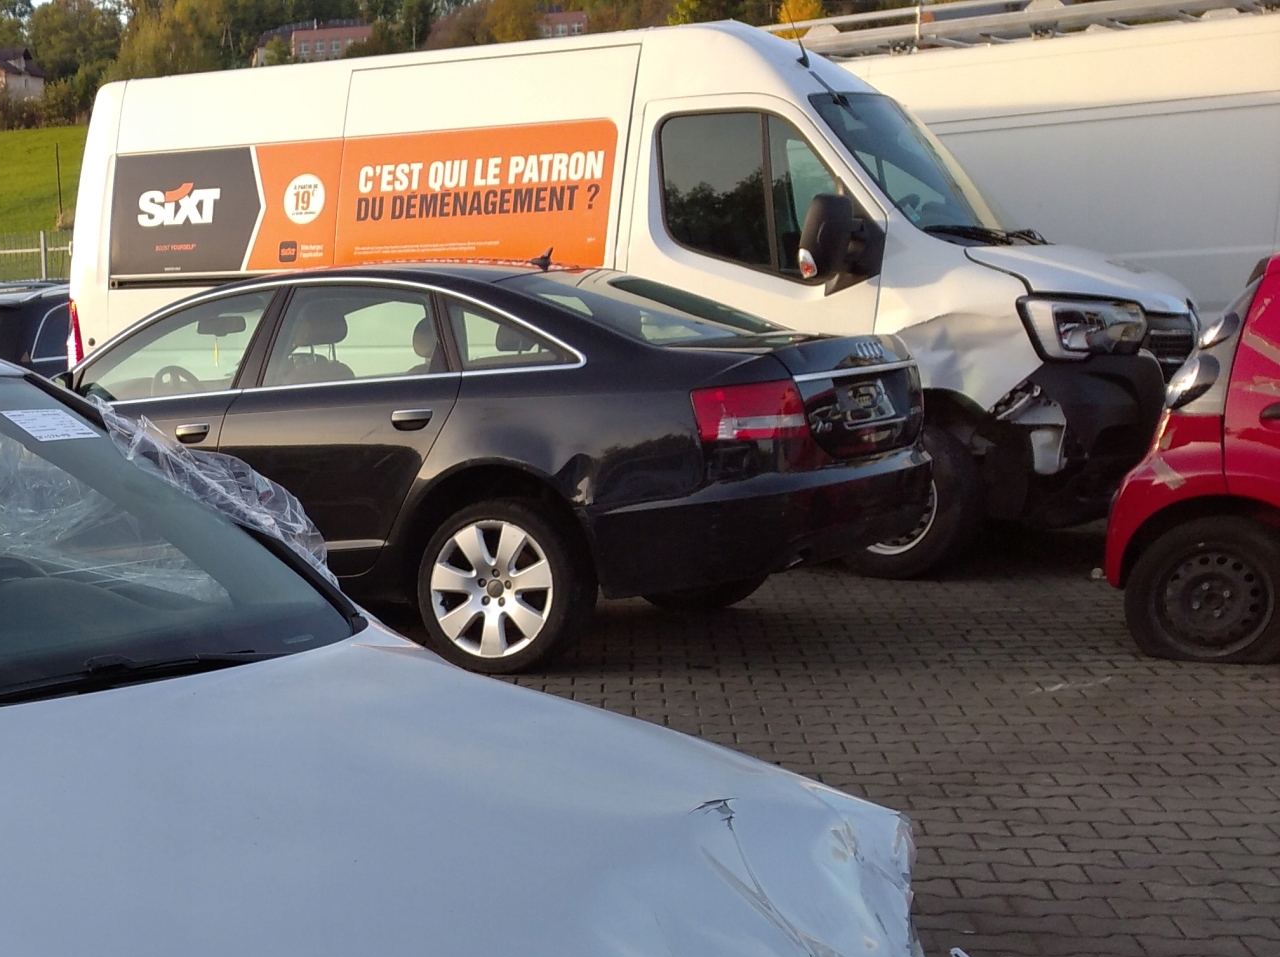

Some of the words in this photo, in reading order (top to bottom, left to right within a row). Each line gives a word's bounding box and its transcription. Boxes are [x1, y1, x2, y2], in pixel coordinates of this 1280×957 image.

[358, 163, 424, 194] C'EST
[428, 159, 469, 192] QUI
[473, 157, 503, 187] LE
[507, 150, 605, 184] PATRON
[356, 196, 384, 222] DU
[390, 184, 579, 220] DÉMÉNAGEMENT
